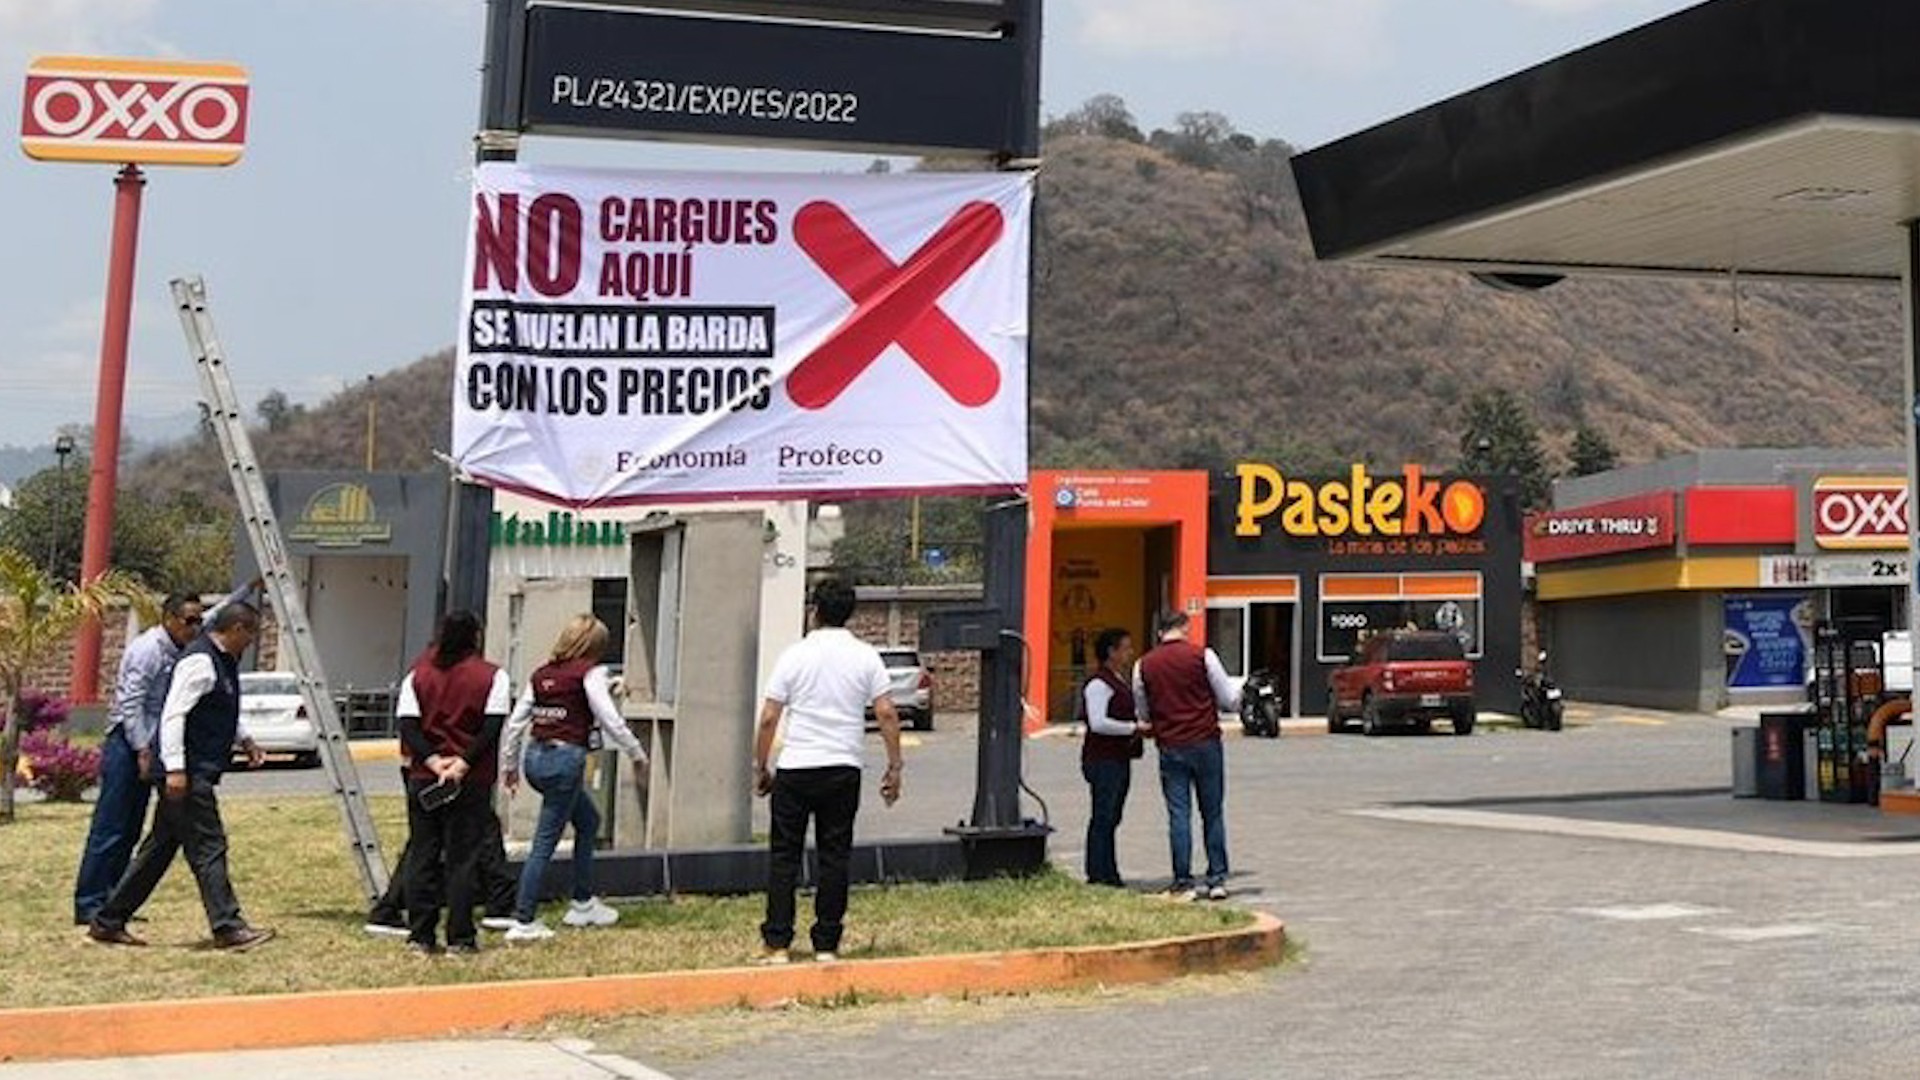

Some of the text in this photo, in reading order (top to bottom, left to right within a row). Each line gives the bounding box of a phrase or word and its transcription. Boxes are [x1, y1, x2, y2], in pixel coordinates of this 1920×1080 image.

[33, 80, 239, 141] OXXO
[552, 75, 858, 122] PL/24321/EXP/ES/2022
[600, 196, 777, 244] CARGUES
[473, 193, 582, 297] NO
[598, 244, 694, 300] AQUÍ
[473, 309, 511, 347] SE
[626, 316, 662, 350] LA
[668, 316, 767, 350] BARDA
[468, 361, 772, 416] CON LOS PRECIOS
[778, 445, 884, 467] Profeco
[1235, 463, 1485, 536] Pasteko
[1820, 489, 1908, 537] OXX
[1549, 517, 1643, 535] DRIVE THRU
